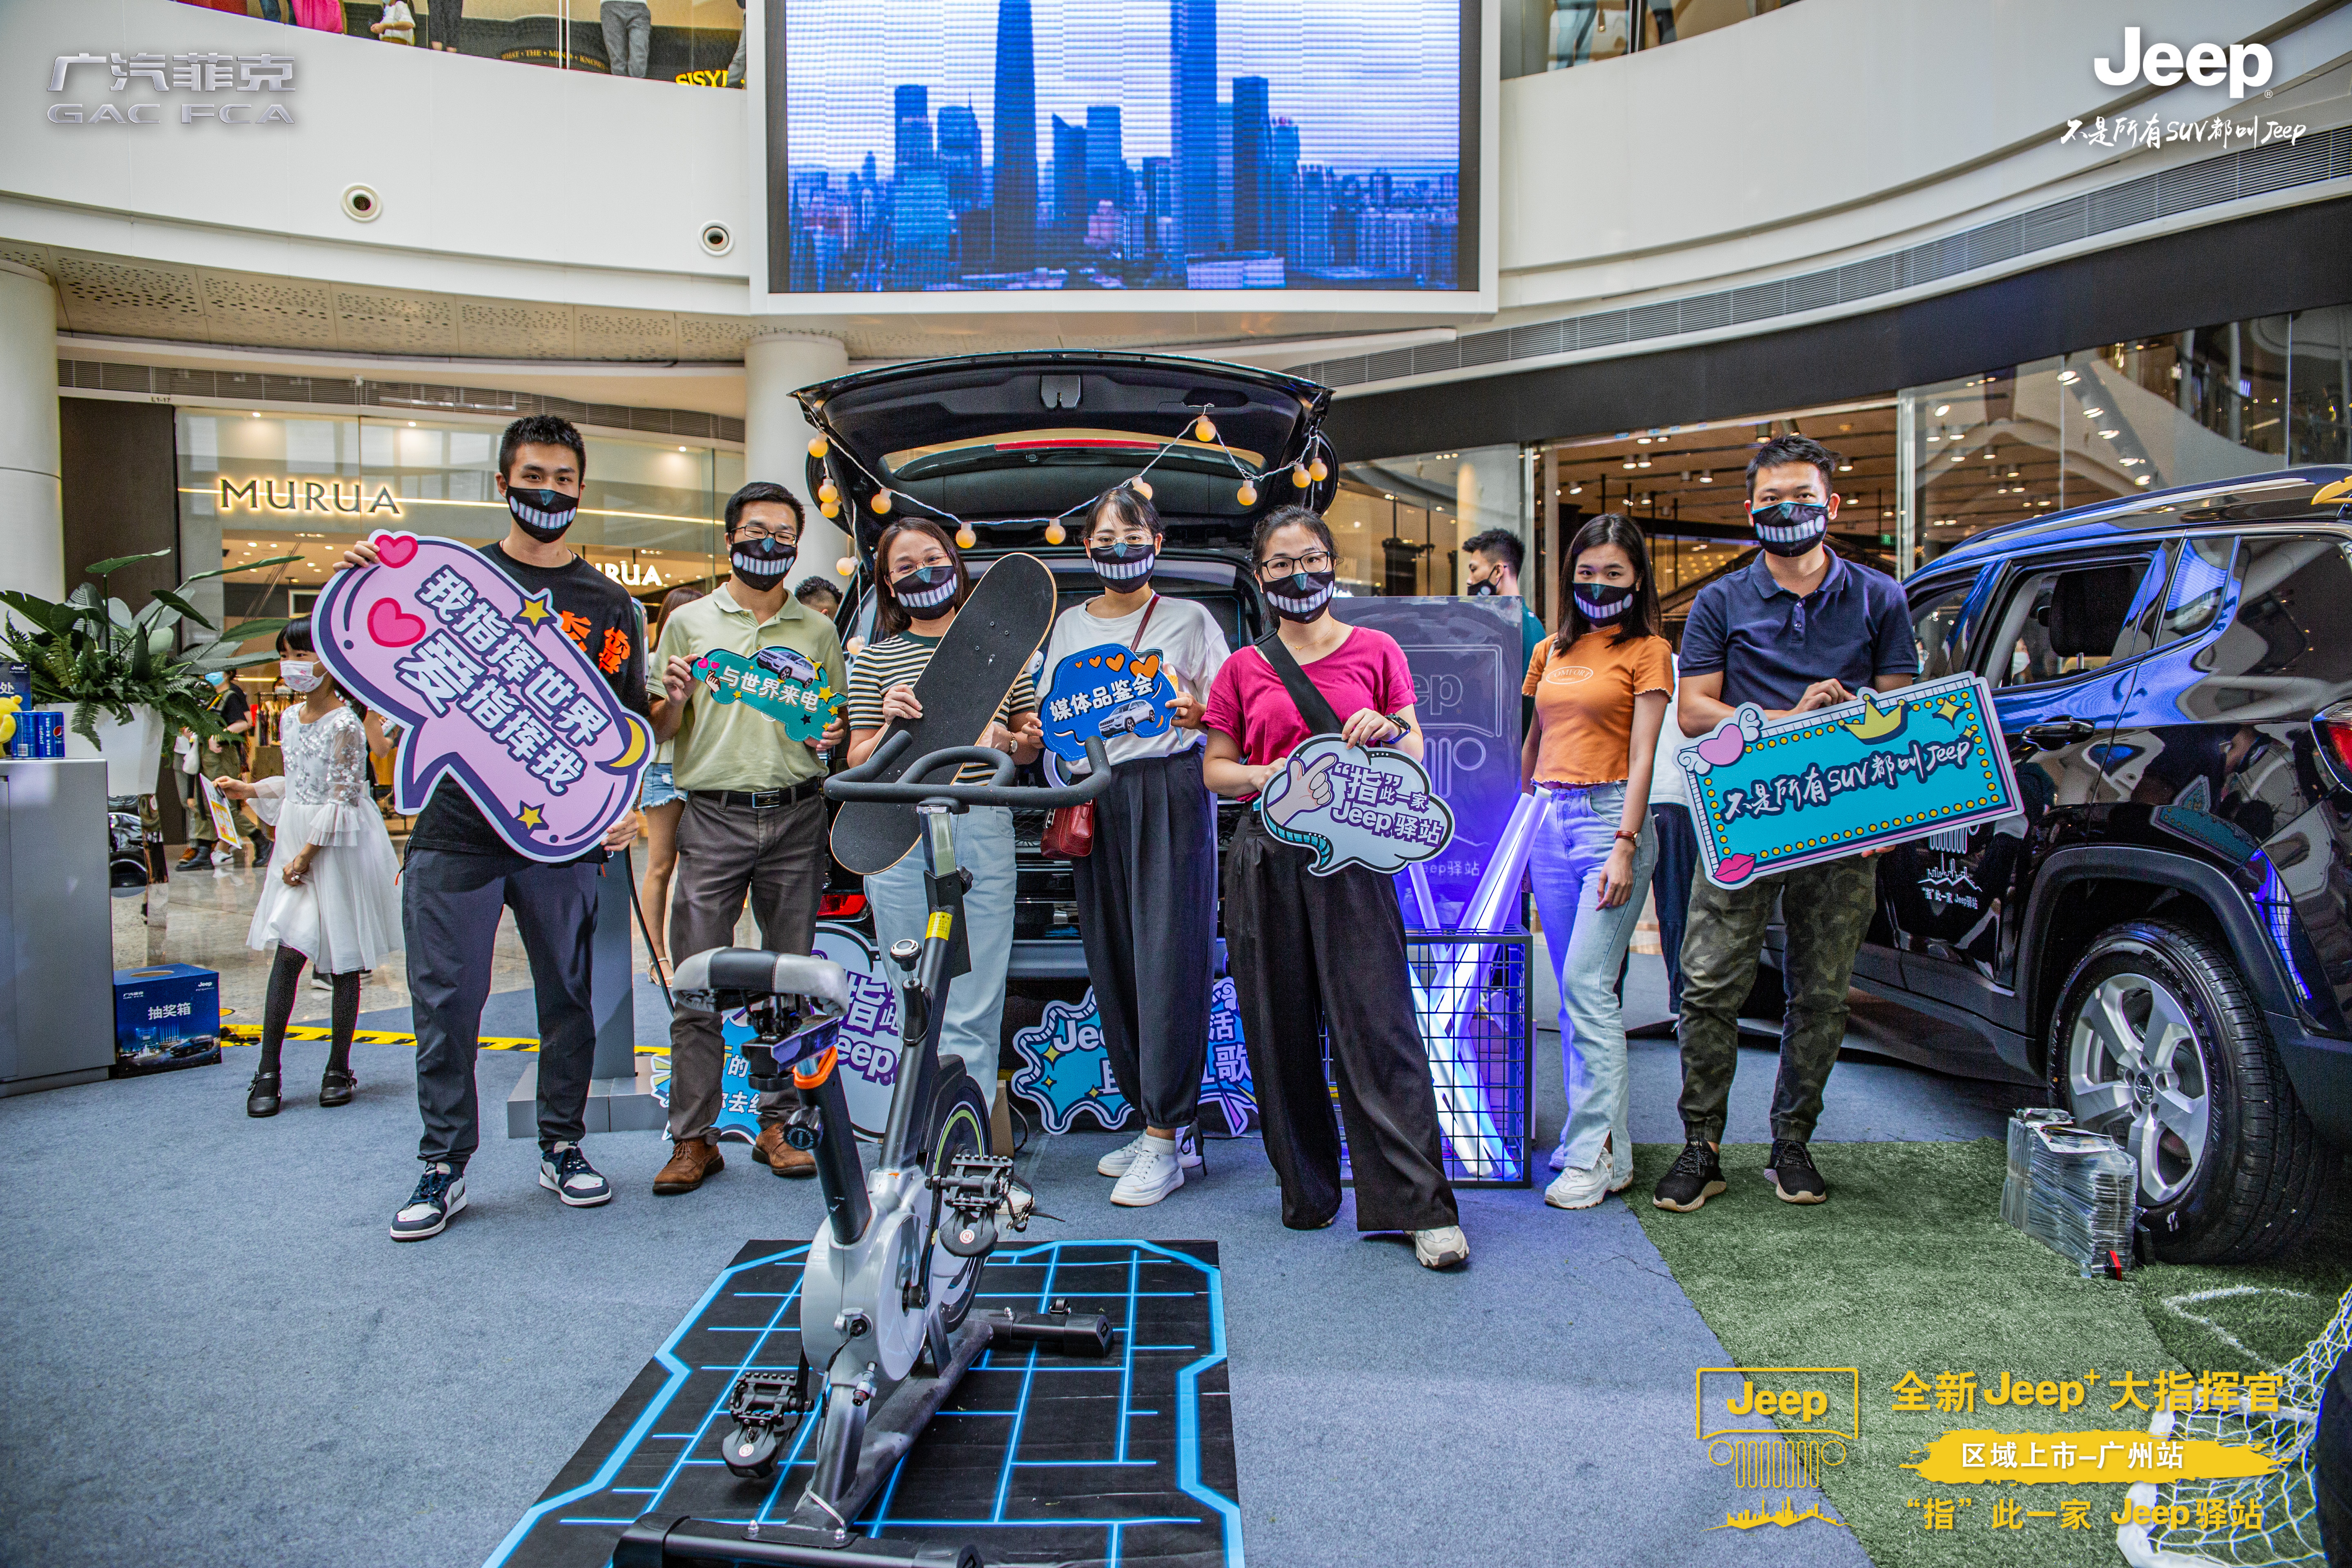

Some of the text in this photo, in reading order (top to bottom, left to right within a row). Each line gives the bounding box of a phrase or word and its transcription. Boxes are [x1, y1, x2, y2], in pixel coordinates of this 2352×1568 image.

[502, 51, 519, 60] WHAT
[219, 479, 400, 514] MURUA
[418, 569, 608, 744] 我指挥世界
[1548, 669, 1591, 679] COMFORT
[719, 666, 820, 712] 与世界来电
[1049, 673, 1154, 722] 媒体品鉴会
[399, 632, 585, 792] 爱指挥我
[1423, 860, 1480, 876] eep驿站
[148, 1002, 191, 1020] 抽奖箱
[837, 1033, 894, 1077] eep
